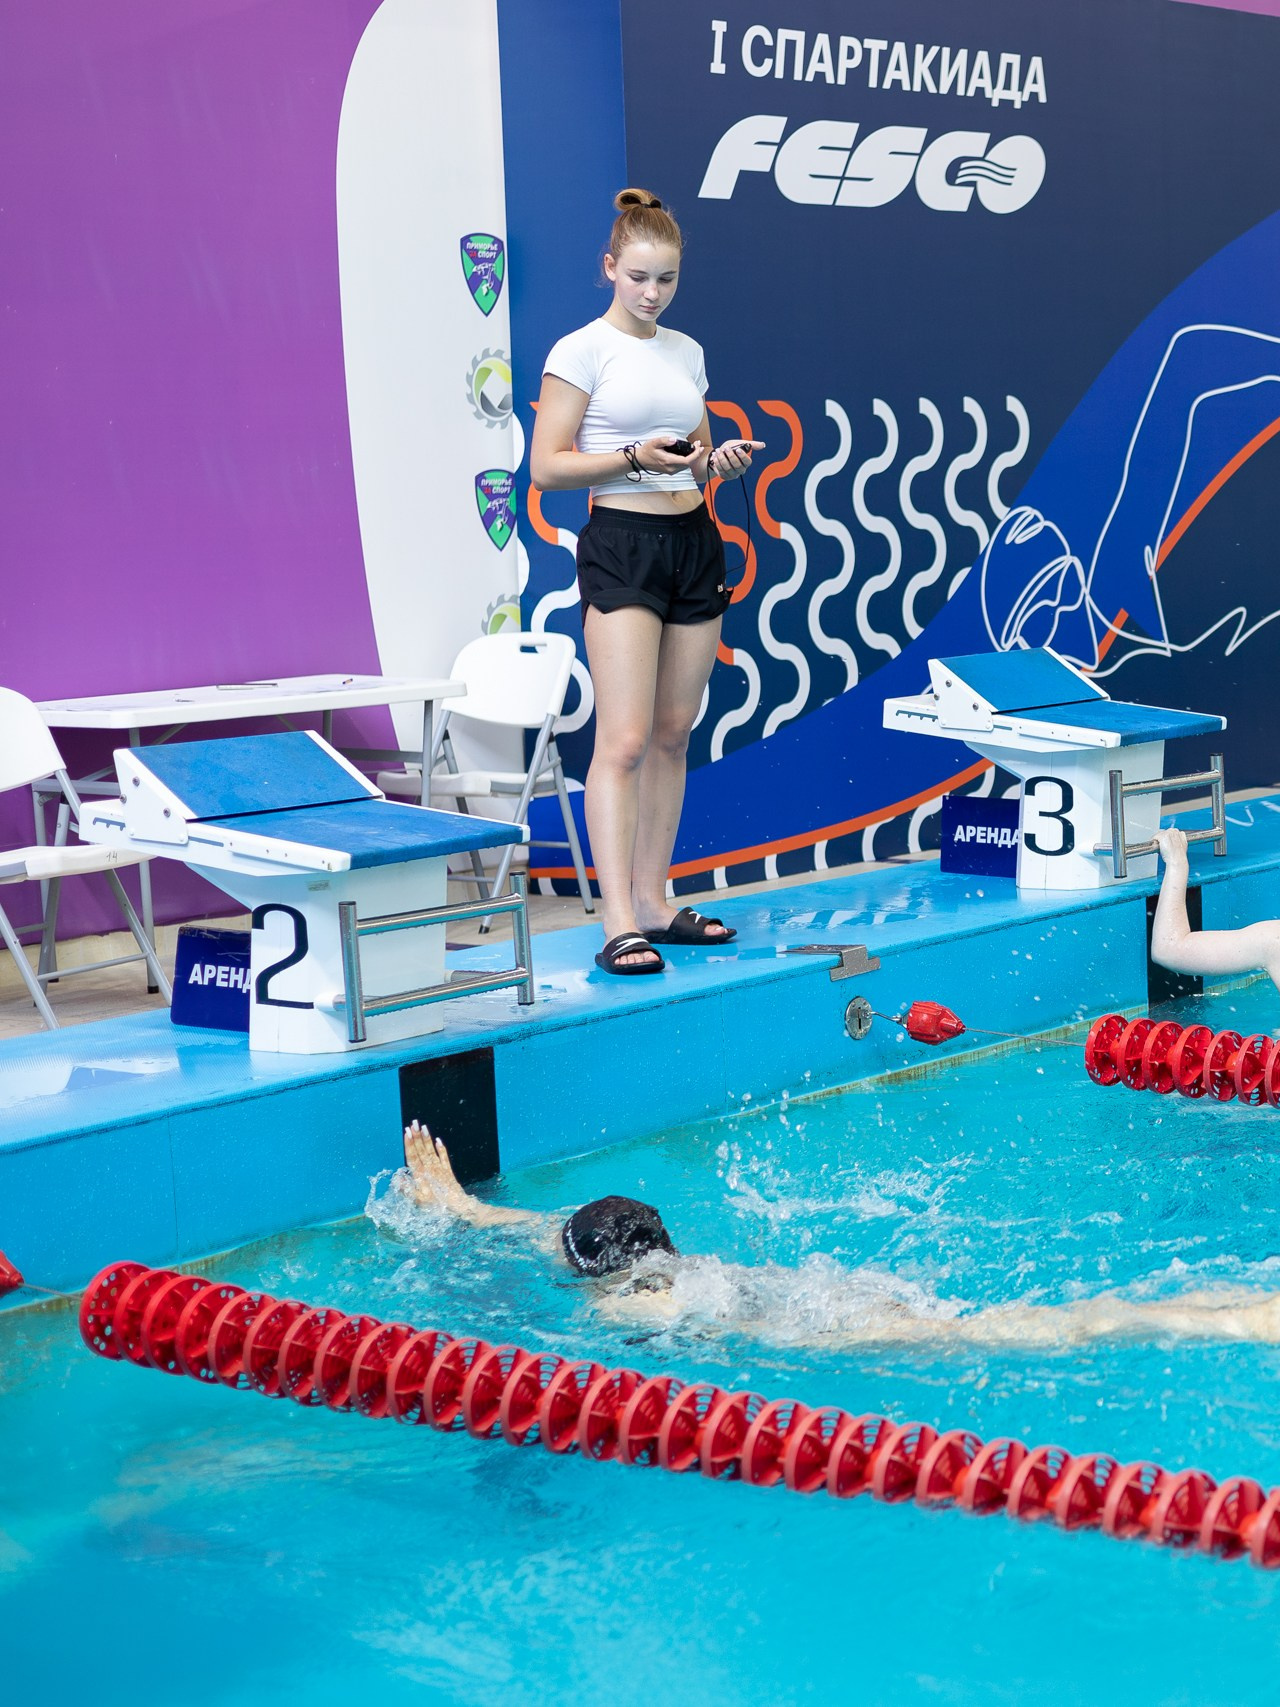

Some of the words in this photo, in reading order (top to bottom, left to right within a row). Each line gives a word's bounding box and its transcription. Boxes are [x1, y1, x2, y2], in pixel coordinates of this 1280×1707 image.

[741, 24, 1048, 109] СПАРТАКИАДА
[697, 114, 1046, 215] FESCO
[1024, 776, 1075, 856] 3
[251, 903, 314, 1009] 2
